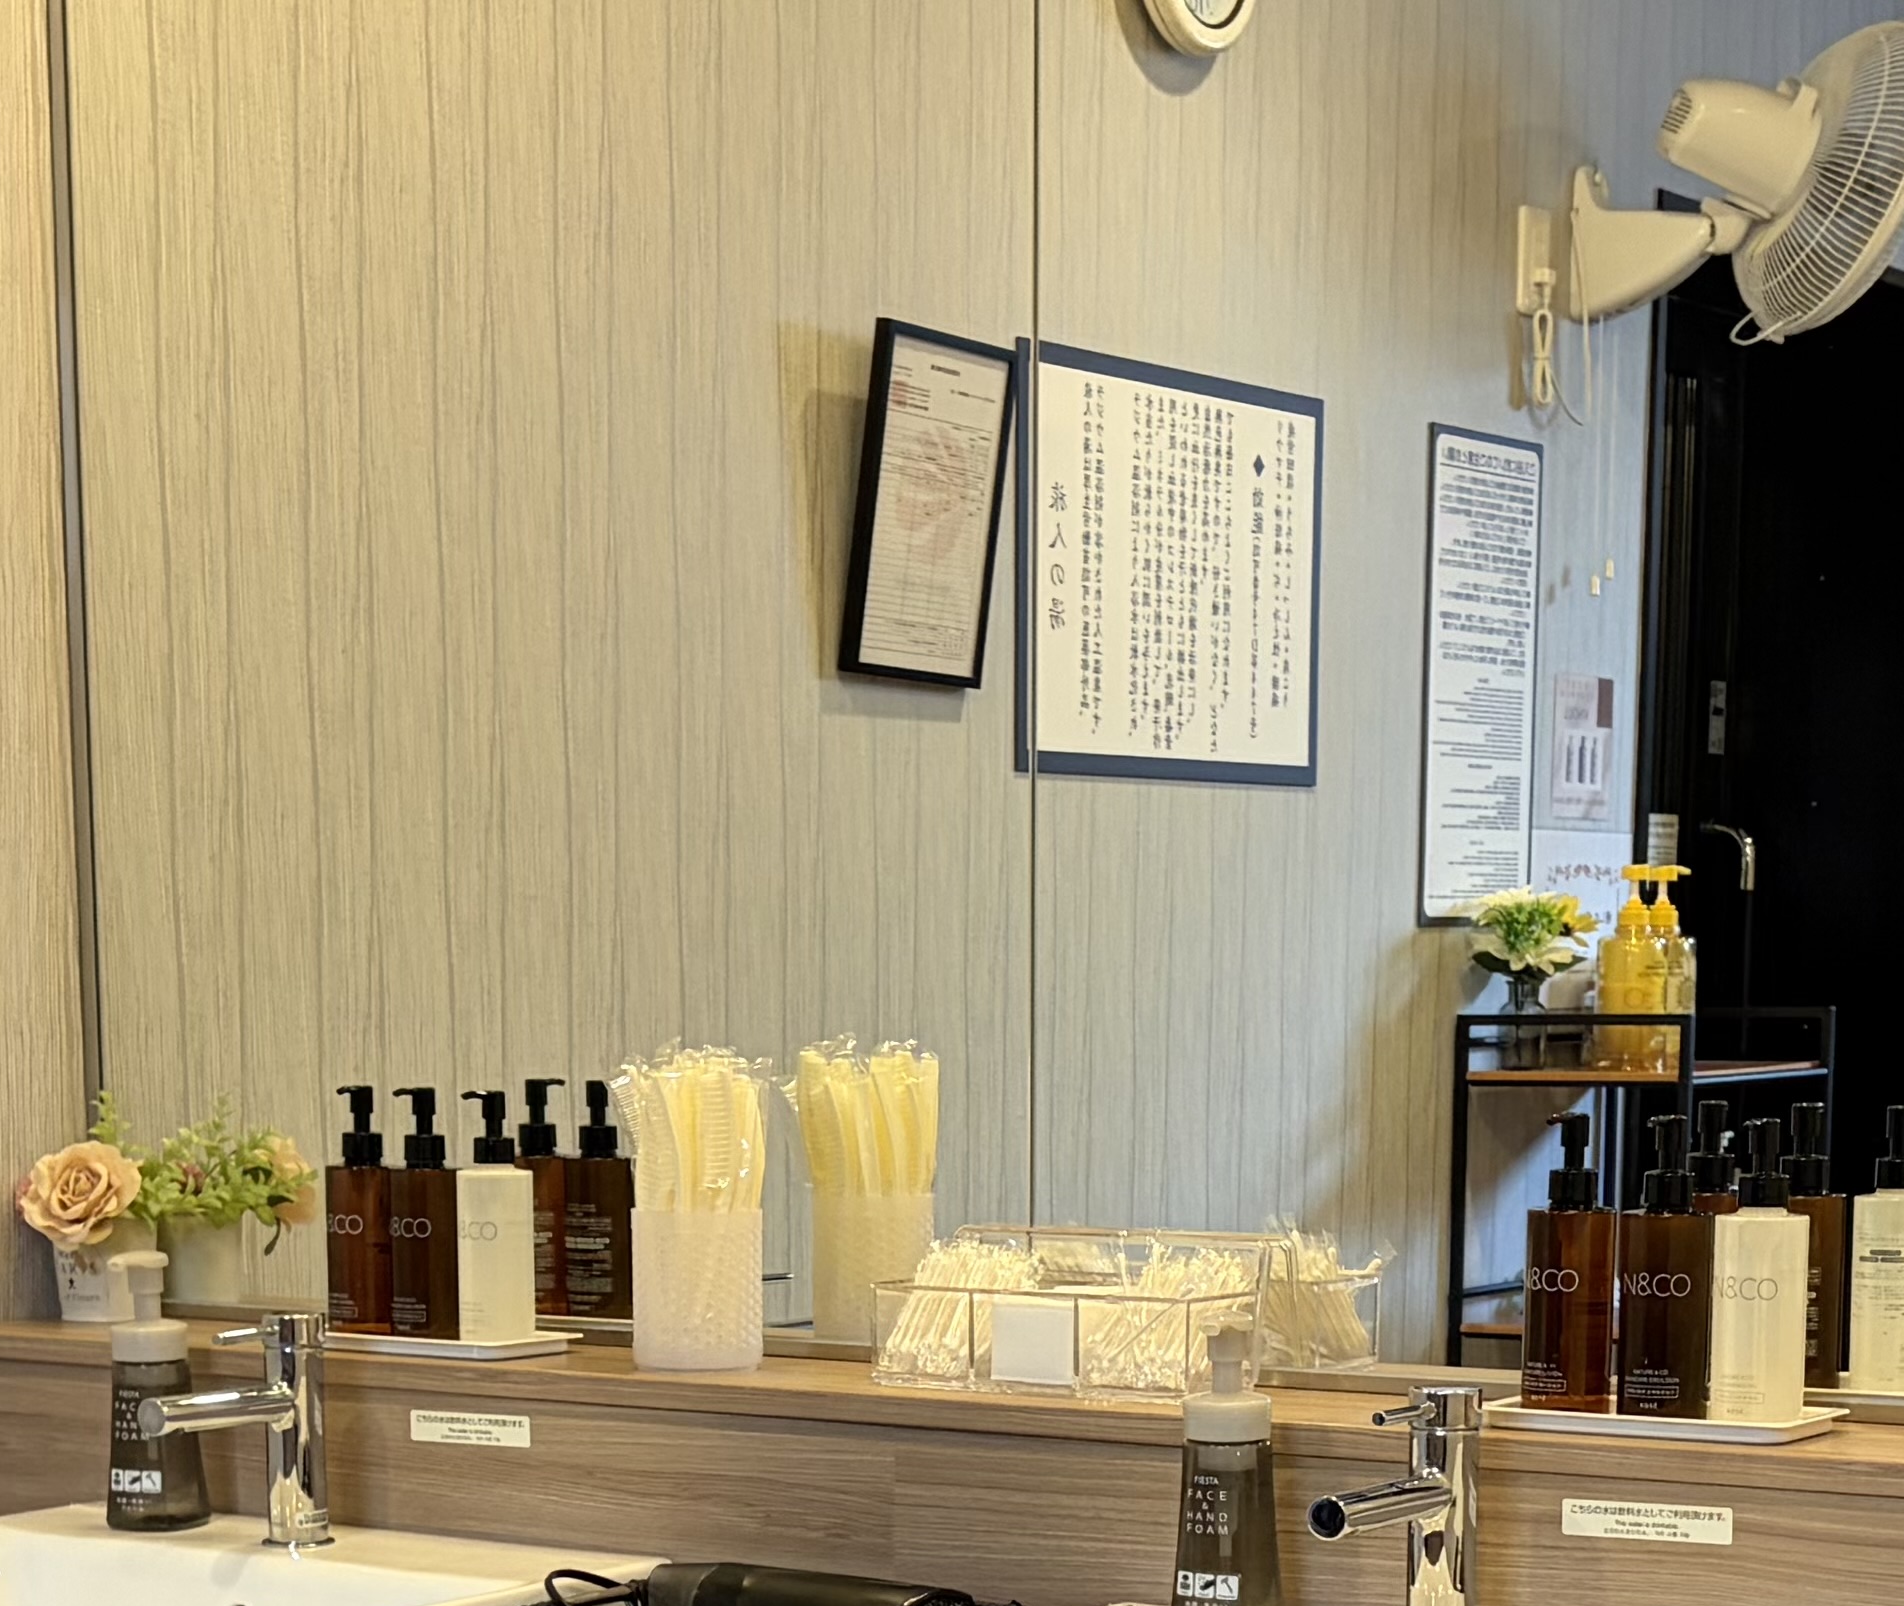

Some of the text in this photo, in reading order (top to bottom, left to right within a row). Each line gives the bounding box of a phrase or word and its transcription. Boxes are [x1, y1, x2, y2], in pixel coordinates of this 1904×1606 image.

[1624, 1272, 1691, 1297] N&CO
[1194, 1475, 1219, 1486] FIESTA
[1187, 1489, 1228, 1501] FACE
[1186, 1511, 1228, 1523] HAND
[1186, 1523, 1229, 1535] FOAM
